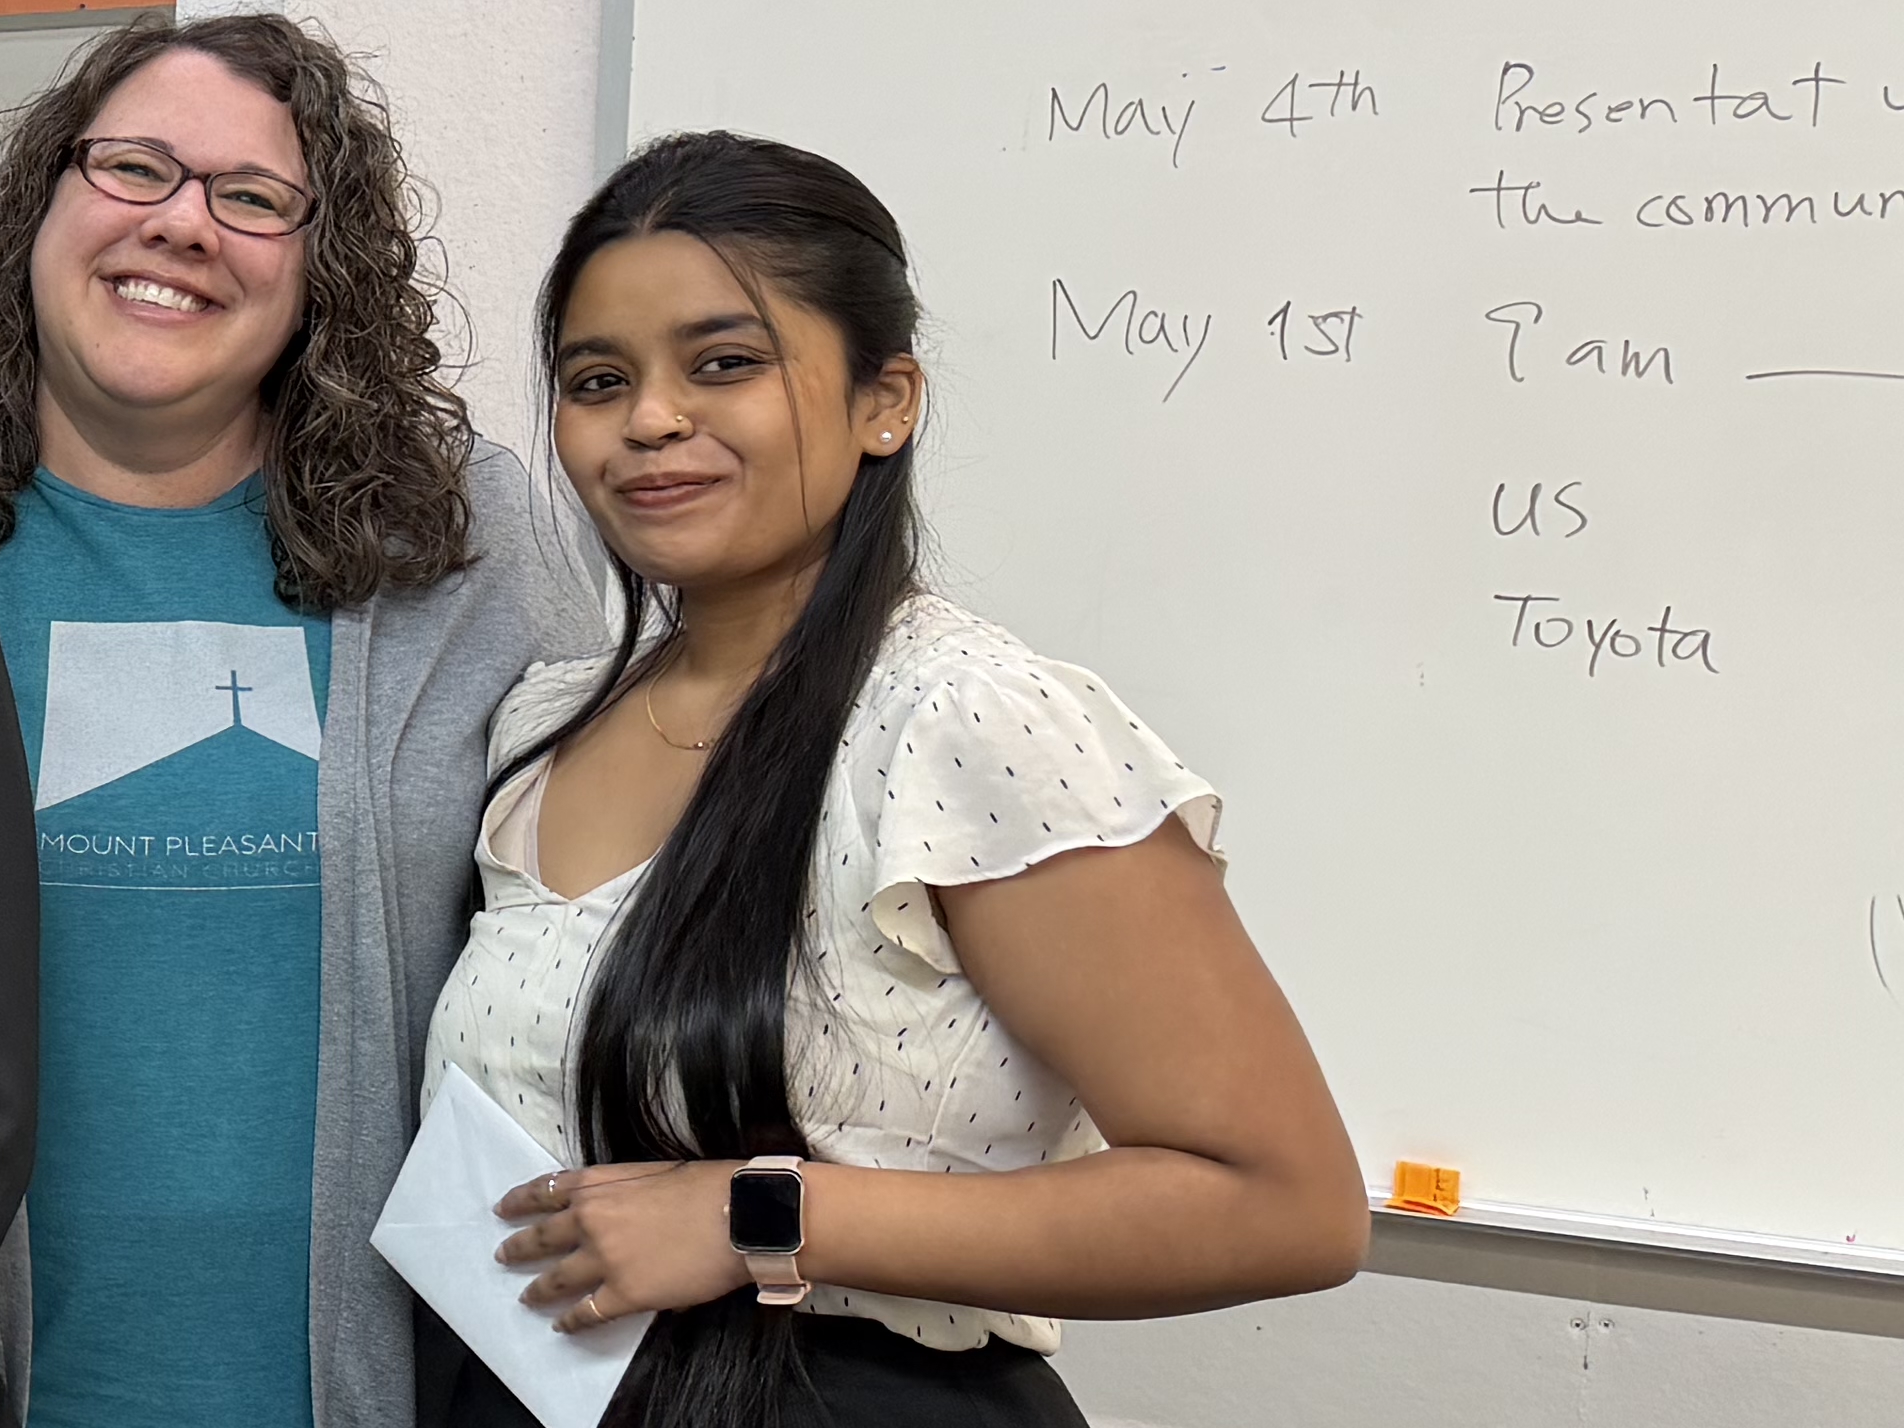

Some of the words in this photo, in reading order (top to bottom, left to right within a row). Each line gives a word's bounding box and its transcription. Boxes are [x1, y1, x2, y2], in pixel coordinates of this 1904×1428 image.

[1048, 81, 1196, 169] May
[1260, 69, 1379, 139] 4th
[1469, 168, 1604, 229] the
[1052, 277, 1212, 404] May
[1565, 339, 1674, 385] am
[1492, 592, 1721, 678] Toyota
[41, 831, 156, 857] MOUNT
[165, 831, 319, 857] PLEASANT
